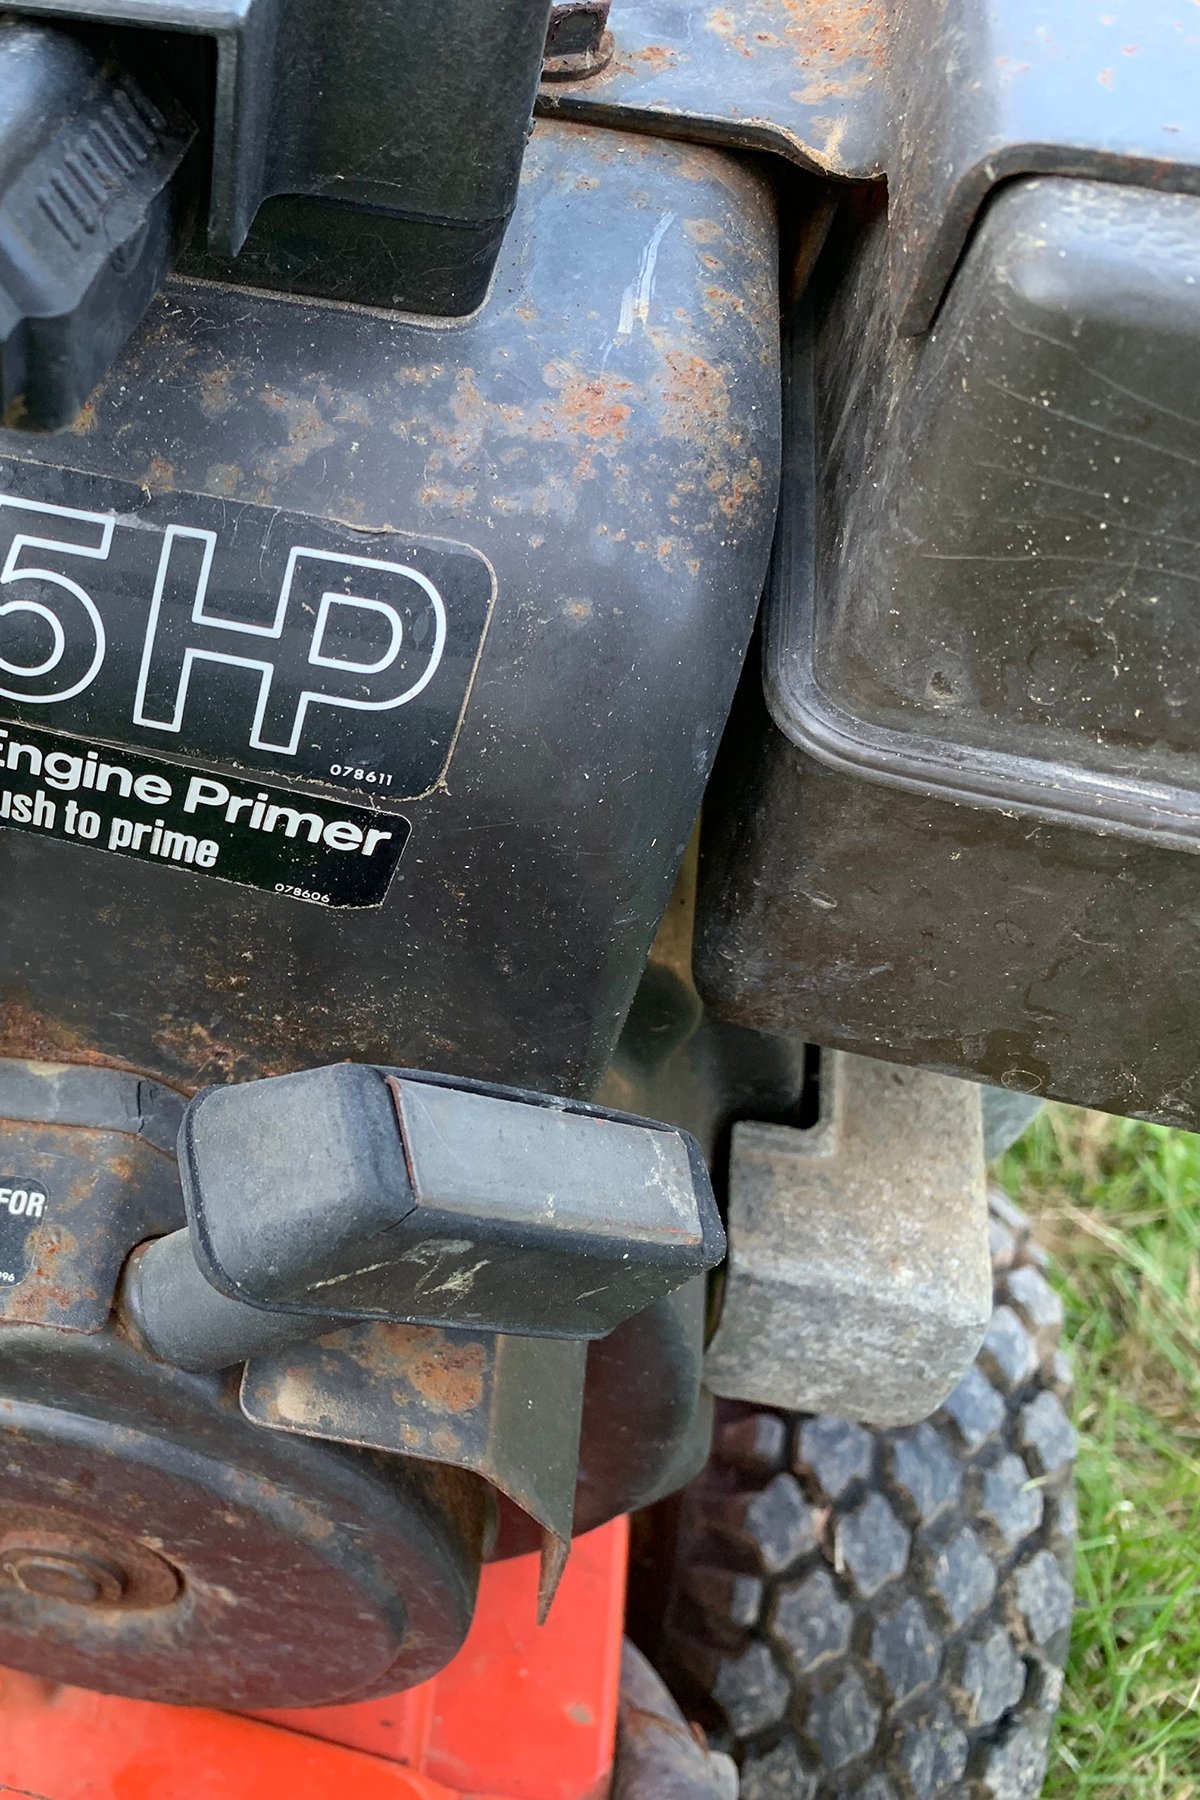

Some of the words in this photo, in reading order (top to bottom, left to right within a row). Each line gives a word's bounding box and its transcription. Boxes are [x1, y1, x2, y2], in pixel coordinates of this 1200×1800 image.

[330, 764, 393, 787] 078611
[64, 799, 100, 839] to
[108, 817, 220, 868] prime
[182, 776, 392, 857] Primer
[274, 882, 331, 904] 078606
